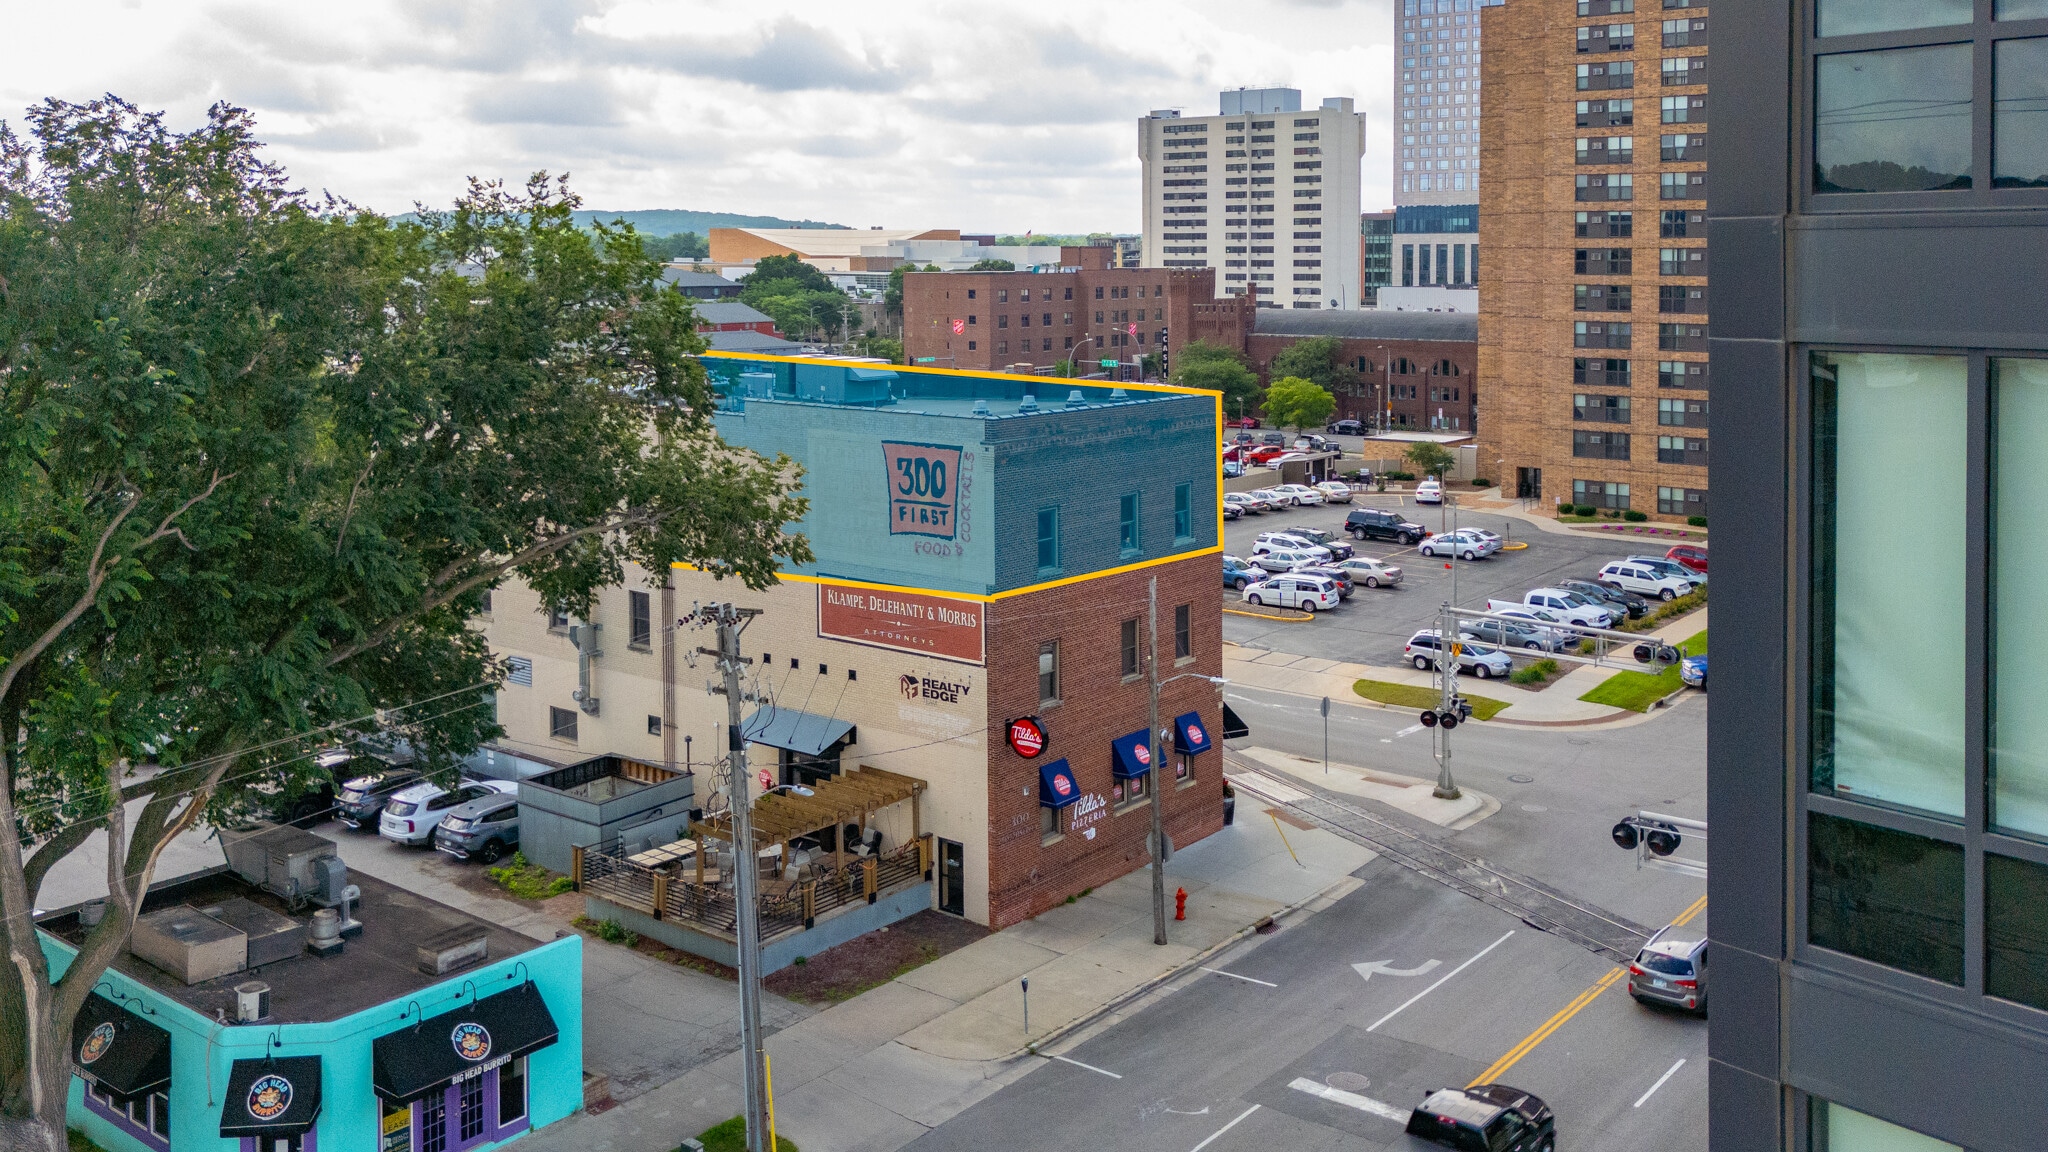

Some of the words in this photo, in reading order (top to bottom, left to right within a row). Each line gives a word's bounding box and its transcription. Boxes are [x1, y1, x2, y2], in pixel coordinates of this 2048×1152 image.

[896, 457, 947, 498] 300
[914, 540, 952, 557] FOOD
[961, 451, 975, 543] COCKTAILS
[898, 506, 949, 526] FIRST
[827, 589, 867, 611] KLAMPE,
[869, 595, 925, 619] DELEHANTY
[927, 608, 935, 621] &
[938, 606, 977, 628] MORRIS
[864, 628, 935, 646] ATTORNEYS
[922, 678, 970, 696] REALTY
[922, 688, 958, 704] EDGE
[1011, 725, 1043, 743] Tilda's
[1071, 792, 1107, 820] Tilda's
[1071, 809, 1107, 830] PIZZERIA
[463, 1025, 482, 1035] HEAD
[463, 1042, 488, 1058] BURRITO
[452, 1073, 464, 1085] BIG
[465, 1065, 482, 1080] HEAD
[483, 1053, 512, 1073] BURRITO
[254, 1081, 269, 1095] BIG
[270, 1079, 288, 1093] HEAD
[252, 1102, 284, 1116] BURRITO
